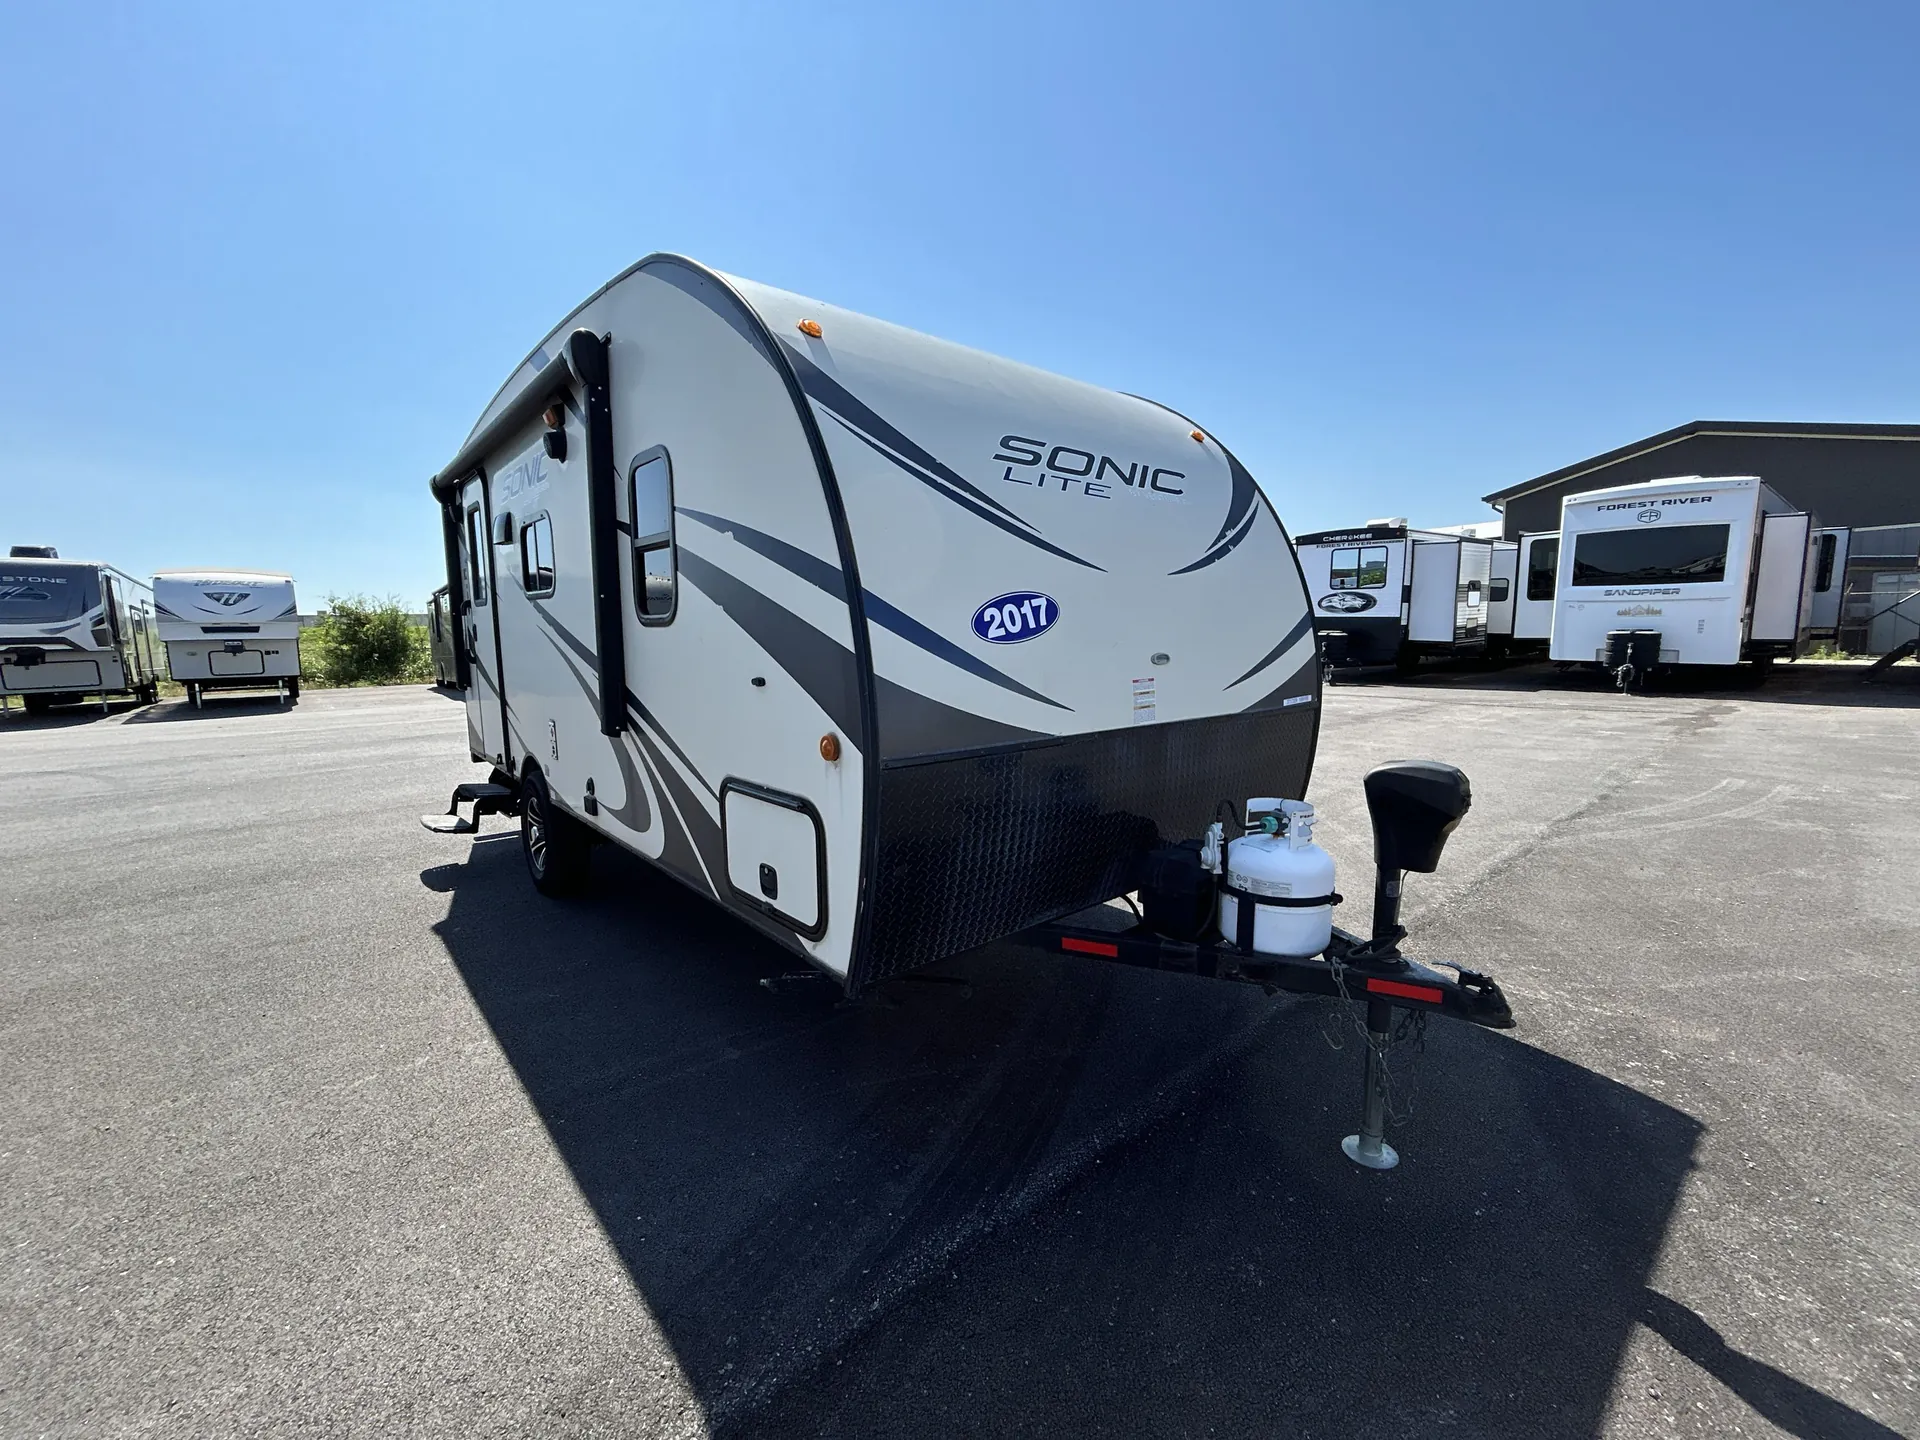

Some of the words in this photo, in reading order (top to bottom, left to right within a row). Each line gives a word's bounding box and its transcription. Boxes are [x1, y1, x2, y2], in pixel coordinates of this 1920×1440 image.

[992, 435, 1186, 496] SONIC
[1003, 466, 1112, 499] LITE
[1597, 500, 1658, 512] FOREST
[1661, 496, 1713, 506] RIVER
[1322, 533, 1373, 542] CHEROKEE
[0, 575, 68, 584] STONE
[1604, 587, 1681, 597] SANDPIPER
[983, 597, 1048, 639] 2017
